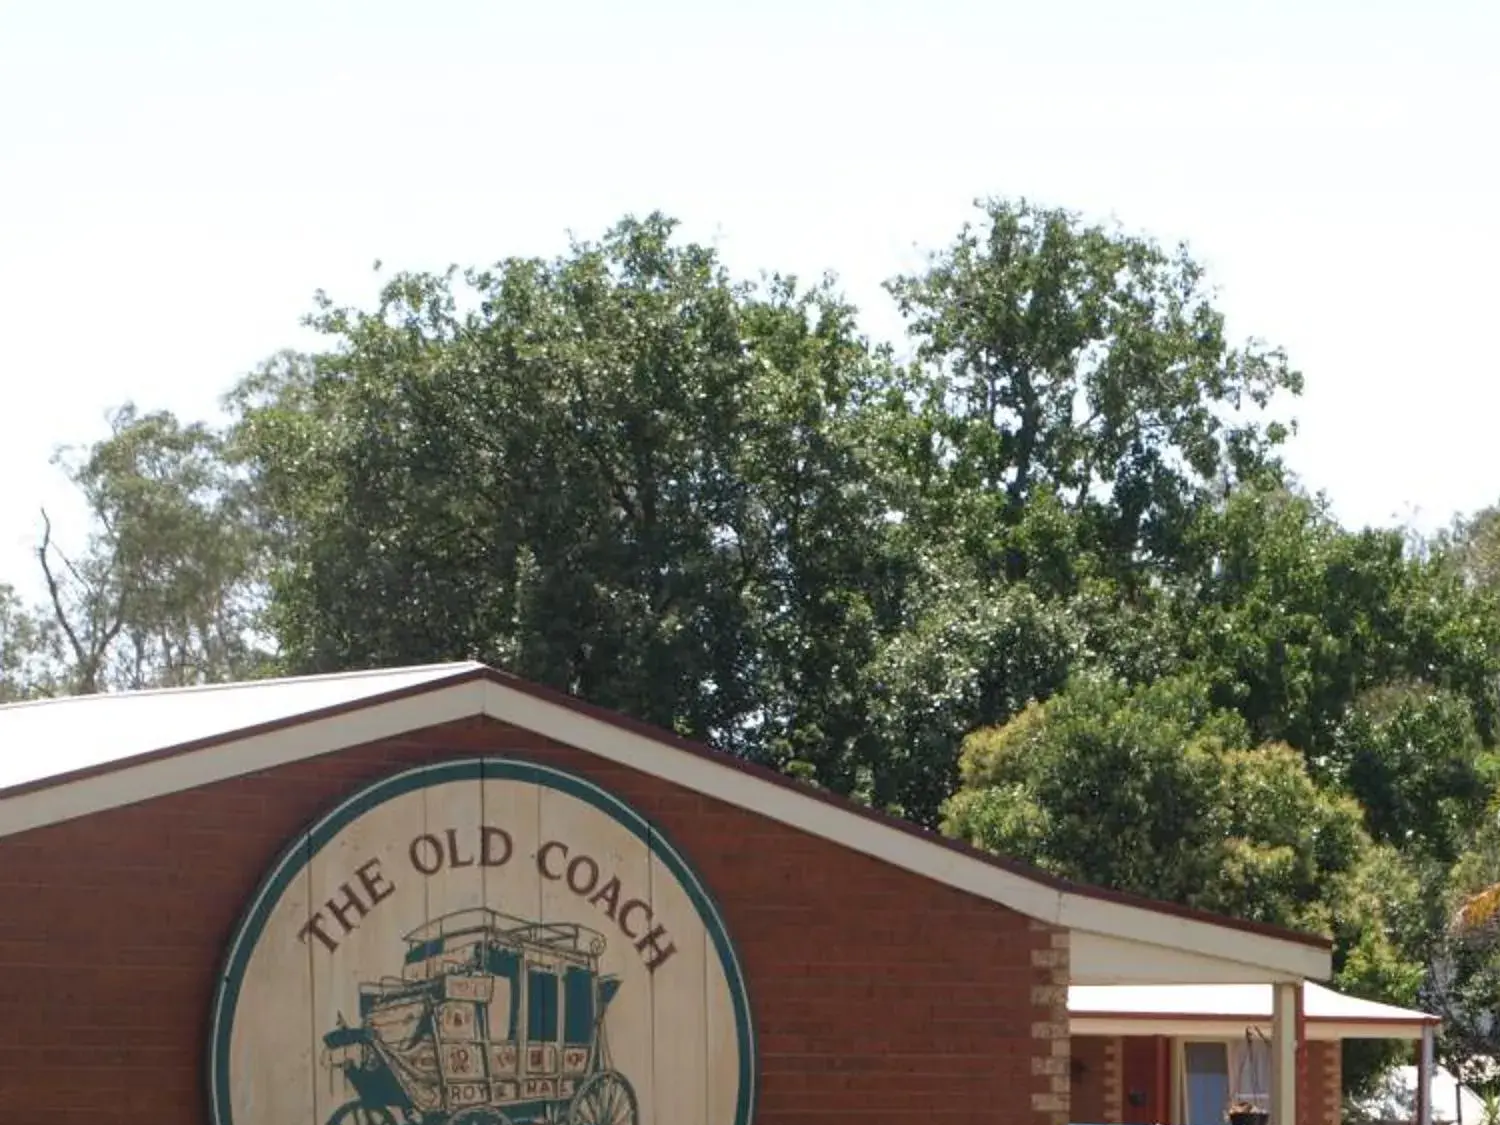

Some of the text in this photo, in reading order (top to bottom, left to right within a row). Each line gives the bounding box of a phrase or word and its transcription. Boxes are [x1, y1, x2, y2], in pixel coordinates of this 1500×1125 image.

[298, 825, 678, 975] THE OLD COACH
